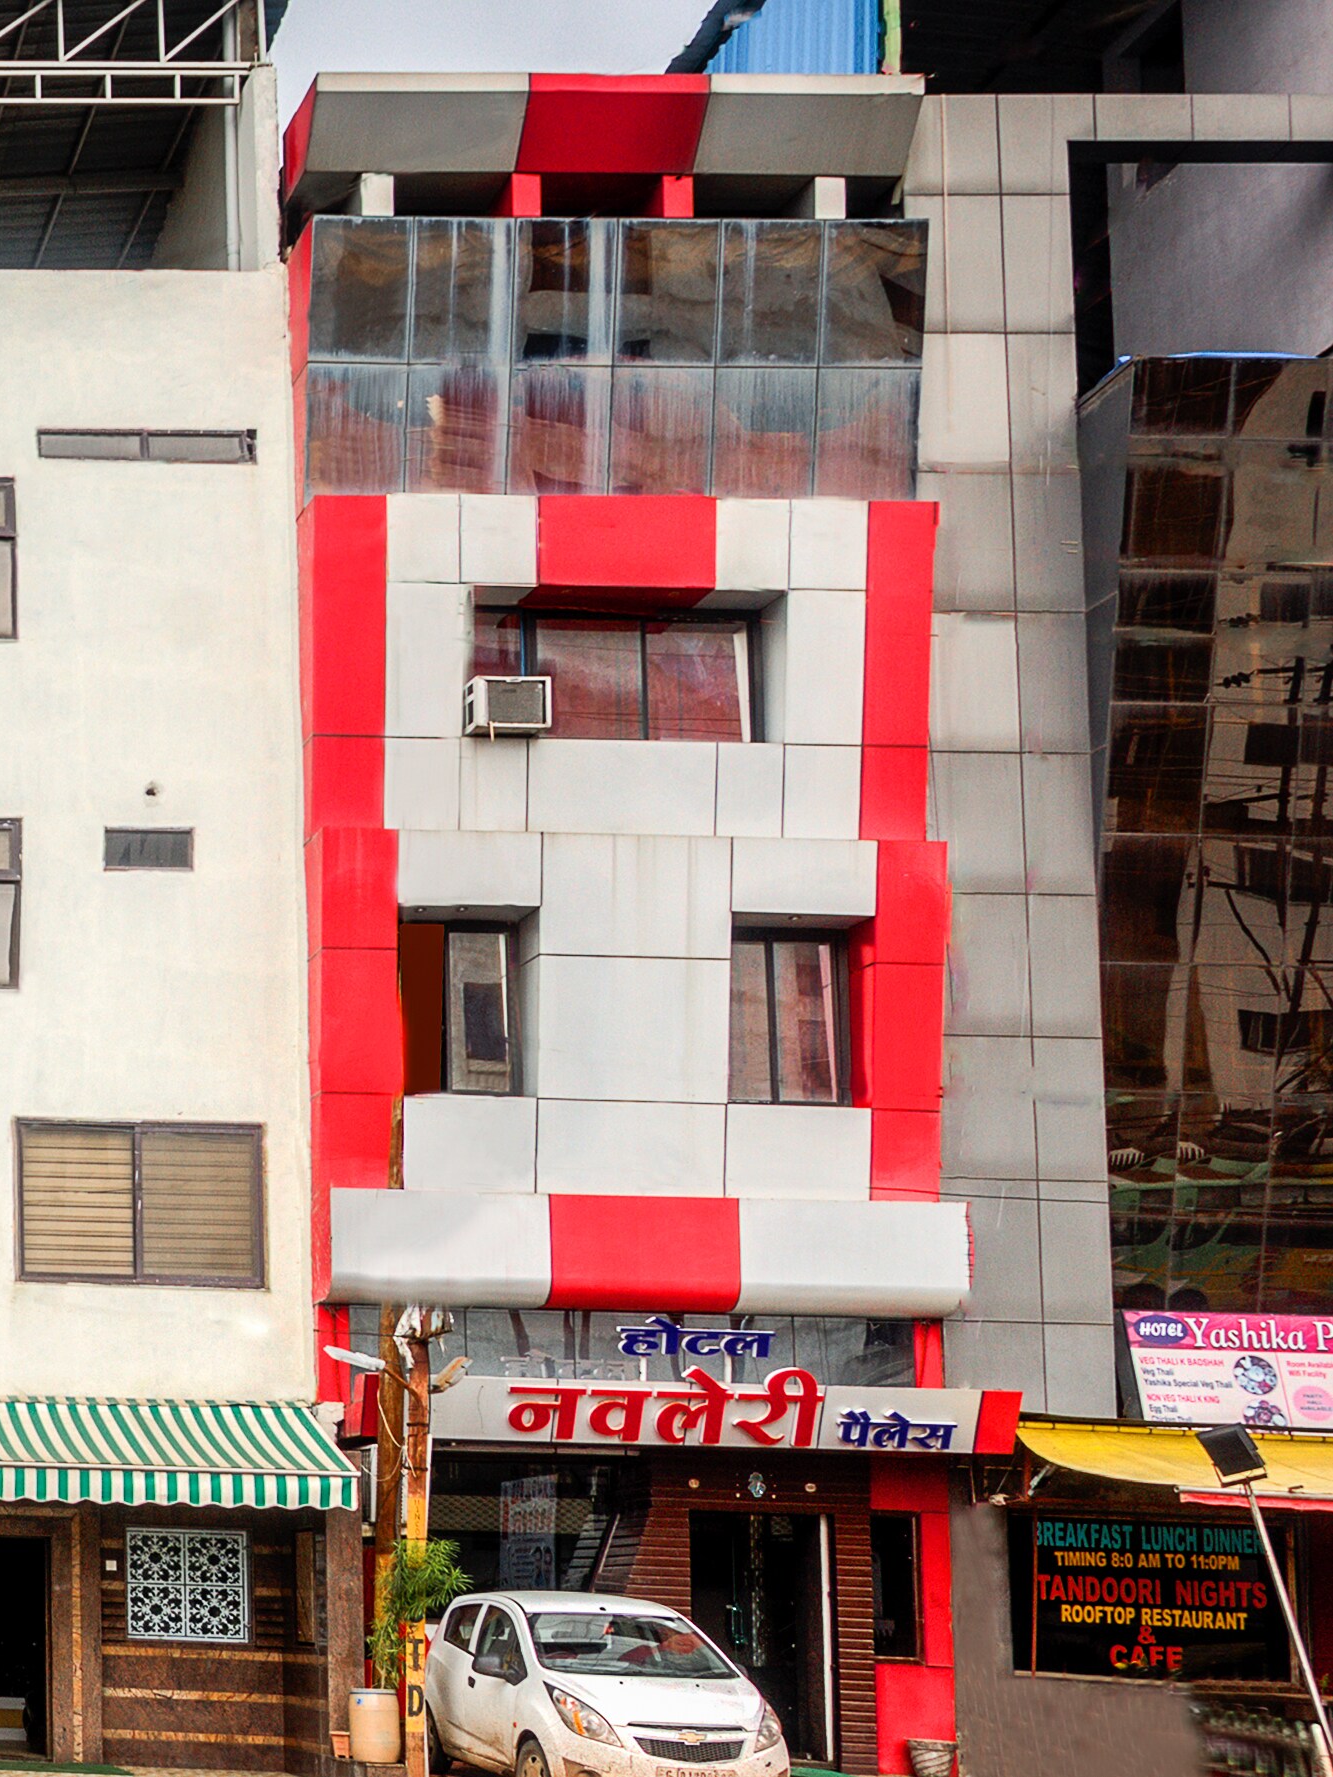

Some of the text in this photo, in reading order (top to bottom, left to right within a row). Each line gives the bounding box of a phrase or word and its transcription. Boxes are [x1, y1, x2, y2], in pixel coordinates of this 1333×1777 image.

[616, 1316, 775, 1358] होटल
[1138, 1321, 1184, 1338] HOTEL
[1184, 1317, 1307, 1350] Yashika
[1139, 1356, 1155, 1365] VEG
[1156, 1356, 1179, 1366] THALI
[1140, 1367, 1156, 1377] Veg
[1144, 1378, 1172, 1387] Yashika
[1173, 1379, 1199, 1389] Special
[507, 1366, 958, 1451] नवलेरी पैलेस
[1037, 1521, 1266, 1554] BREAKFAST LUNCH DINNER
[1054, 1551, 1107, 1567] TIMING
[1111, 1553, 1133, 1568] 8:0
[1138, 1553, 1161, 1568] AM
[1164, 1554, 1185, 1569] TO
[1037, 1574, 1267, 1609] TANDOORI NIGHTS
[1061, 1604, 1248, 1630] ROOFTOP RESTAURANT
[1137, 1625, 1156, 1645] &
[1109, 1644, 1184, 1669] CAFE
